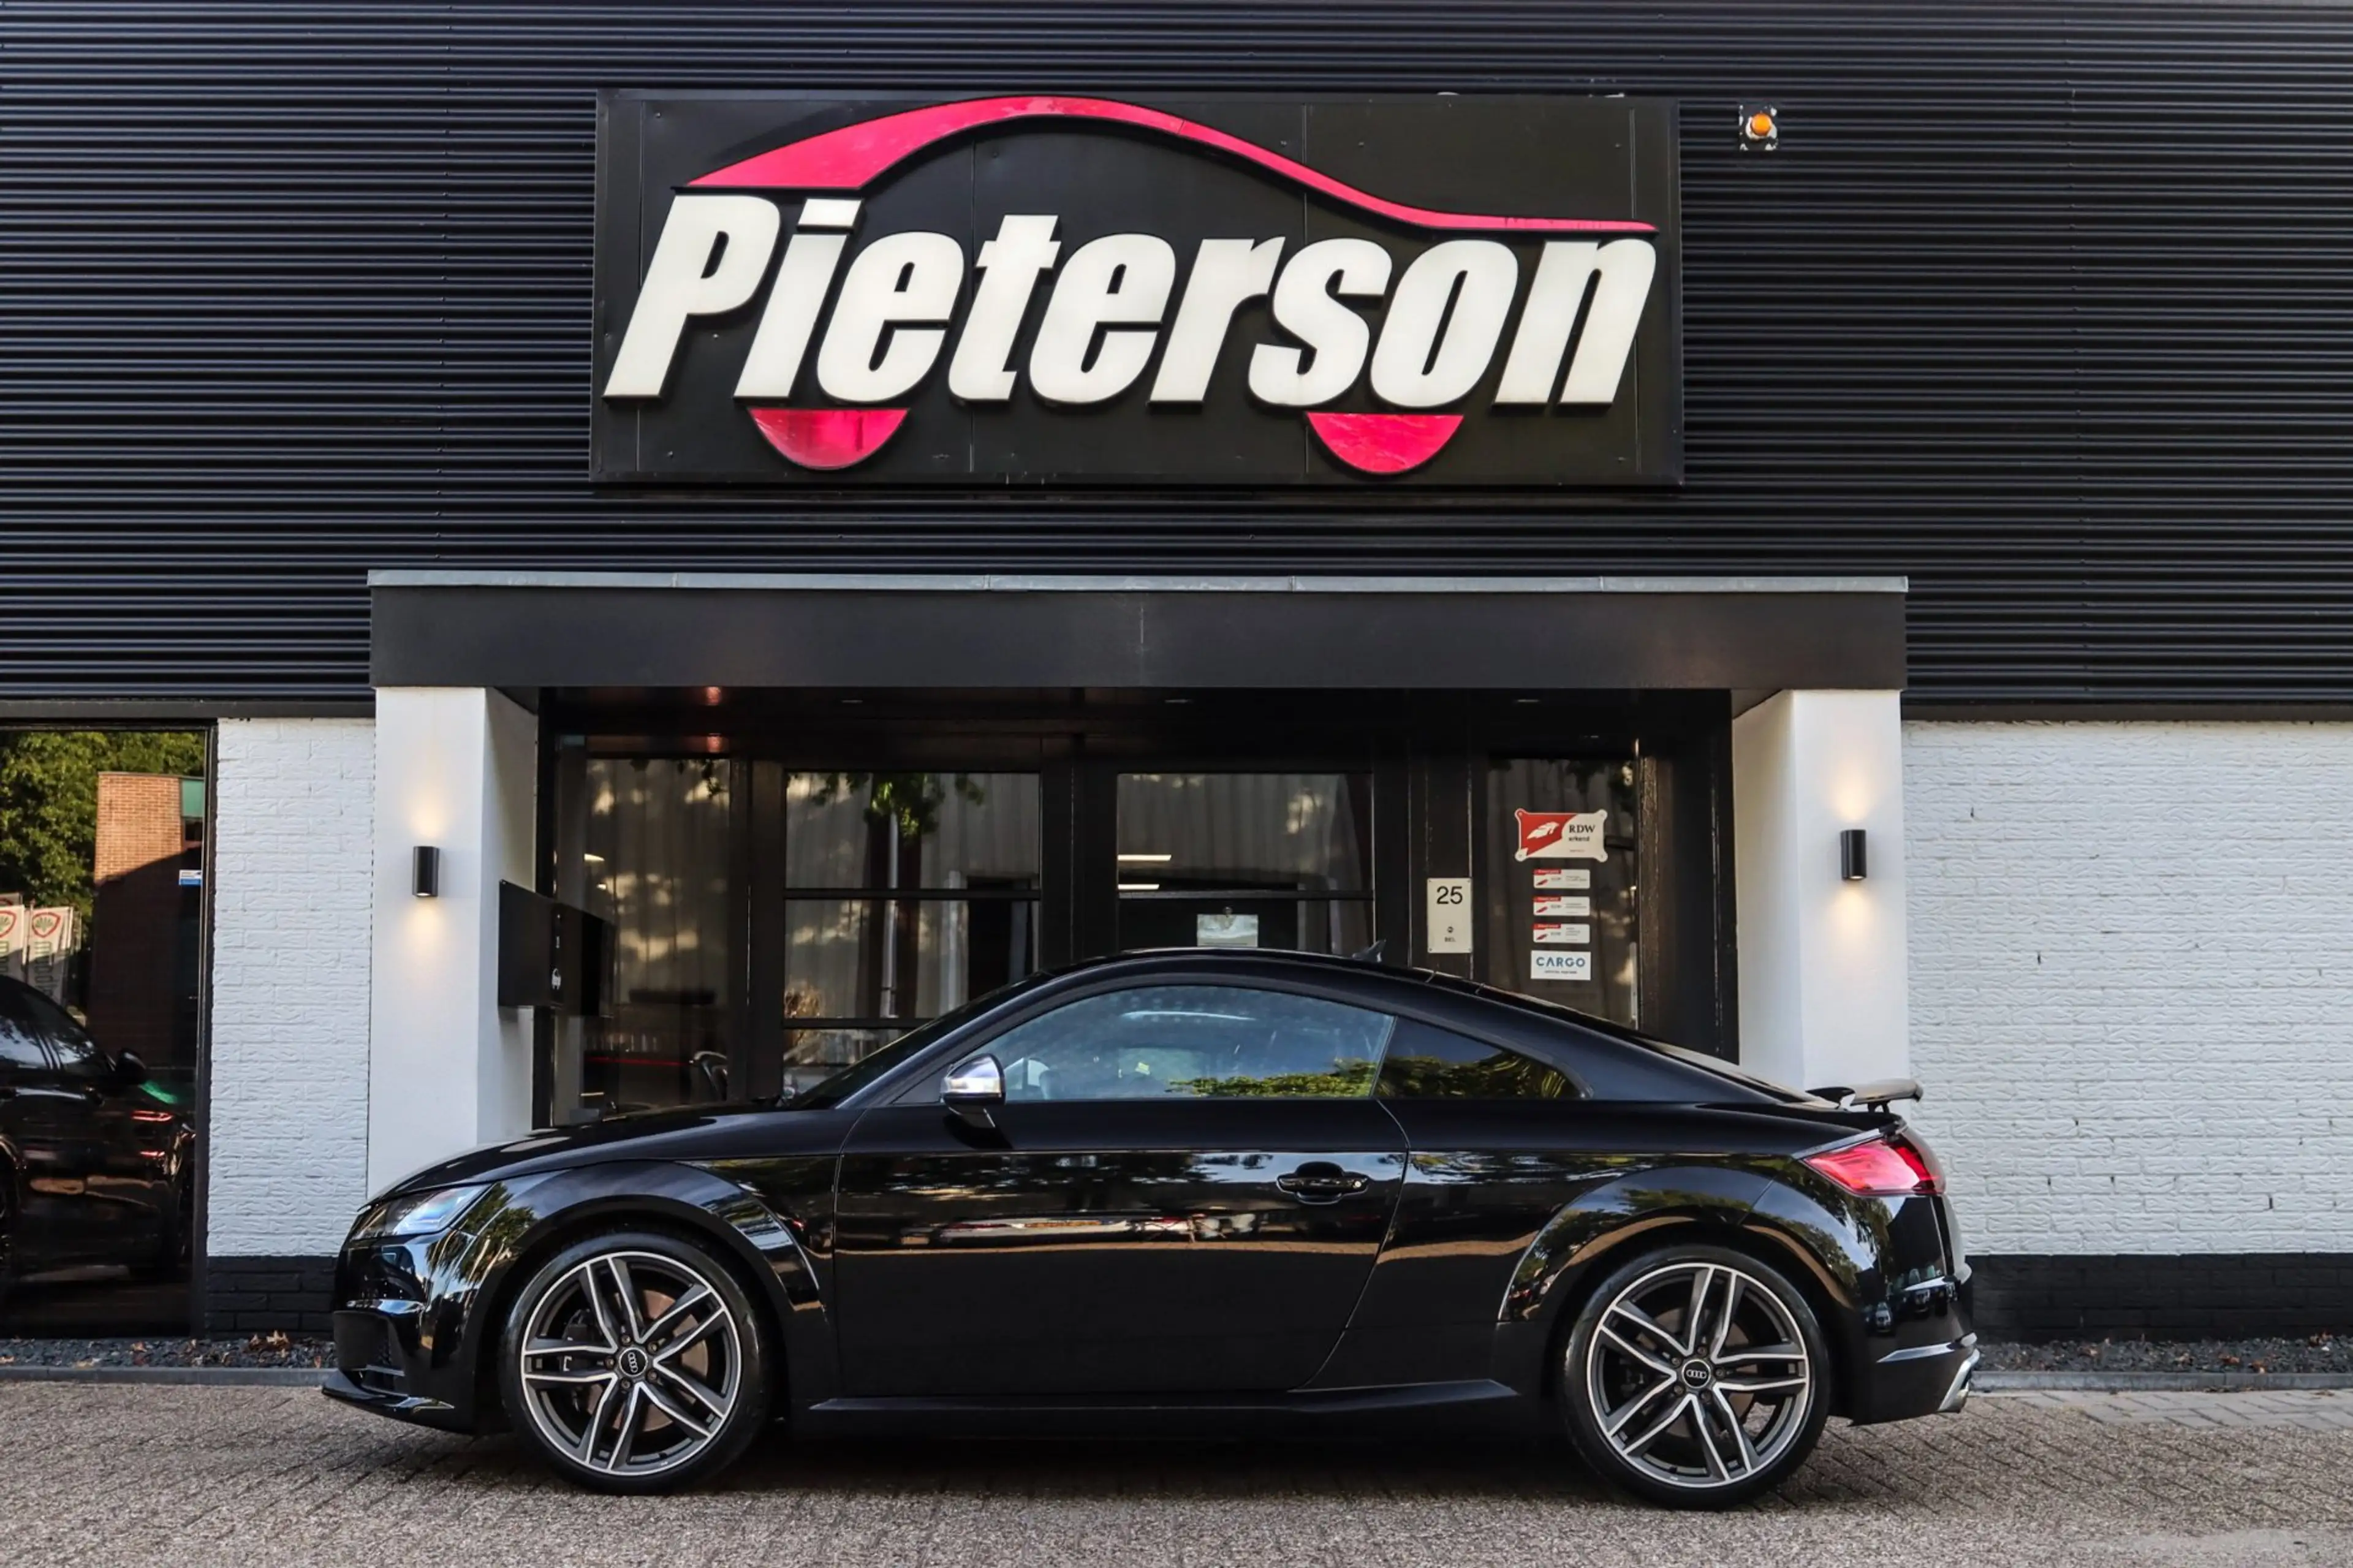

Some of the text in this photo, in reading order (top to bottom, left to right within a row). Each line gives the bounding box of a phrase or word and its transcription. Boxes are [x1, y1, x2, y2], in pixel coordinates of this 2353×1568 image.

[603, 195, 1656, 407] Pieterson
[1569, 824, 1596, 833] RDW
[1436, 886, 1463, 904] 25
[1536, 956, 1585, 967] CARGO
